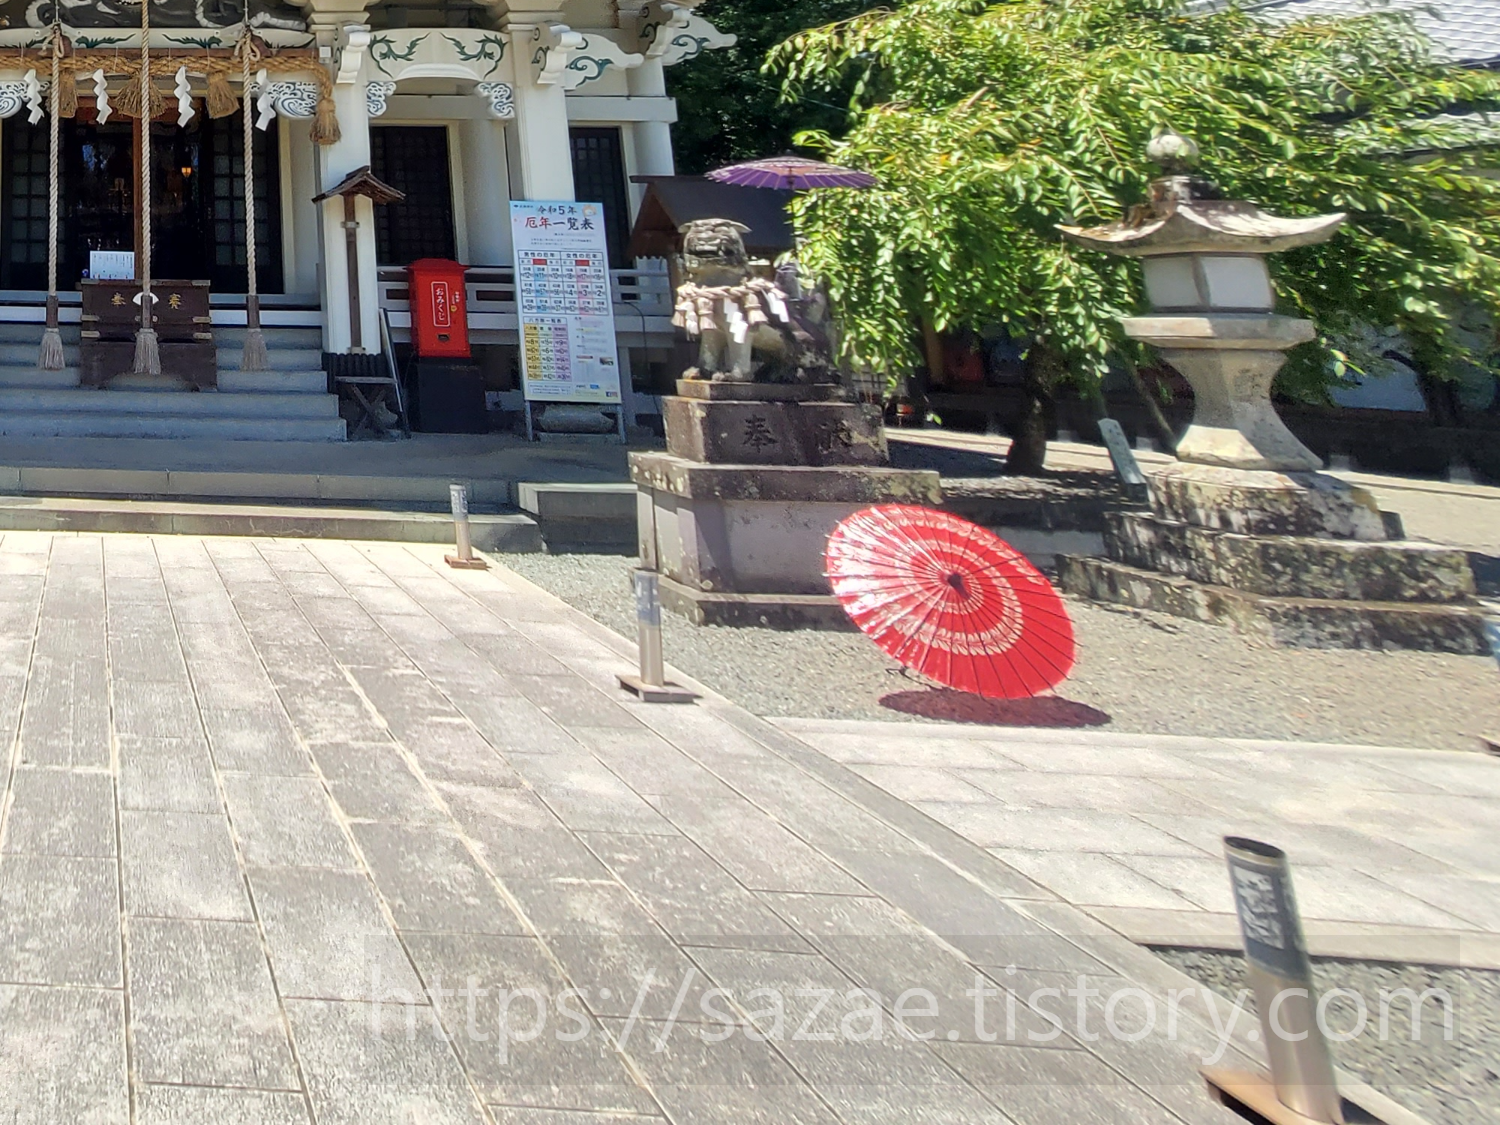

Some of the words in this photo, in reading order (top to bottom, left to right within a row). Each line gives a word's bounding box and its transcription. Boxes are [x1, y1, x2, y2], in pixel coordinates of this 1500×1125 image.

[537, 205, 578, 215] 令和5年
[525, 216, 594, 231] 厄年一覧表
[436, 287, 445, 321] おみくじ
[743, 414, 779, 454] 奉
